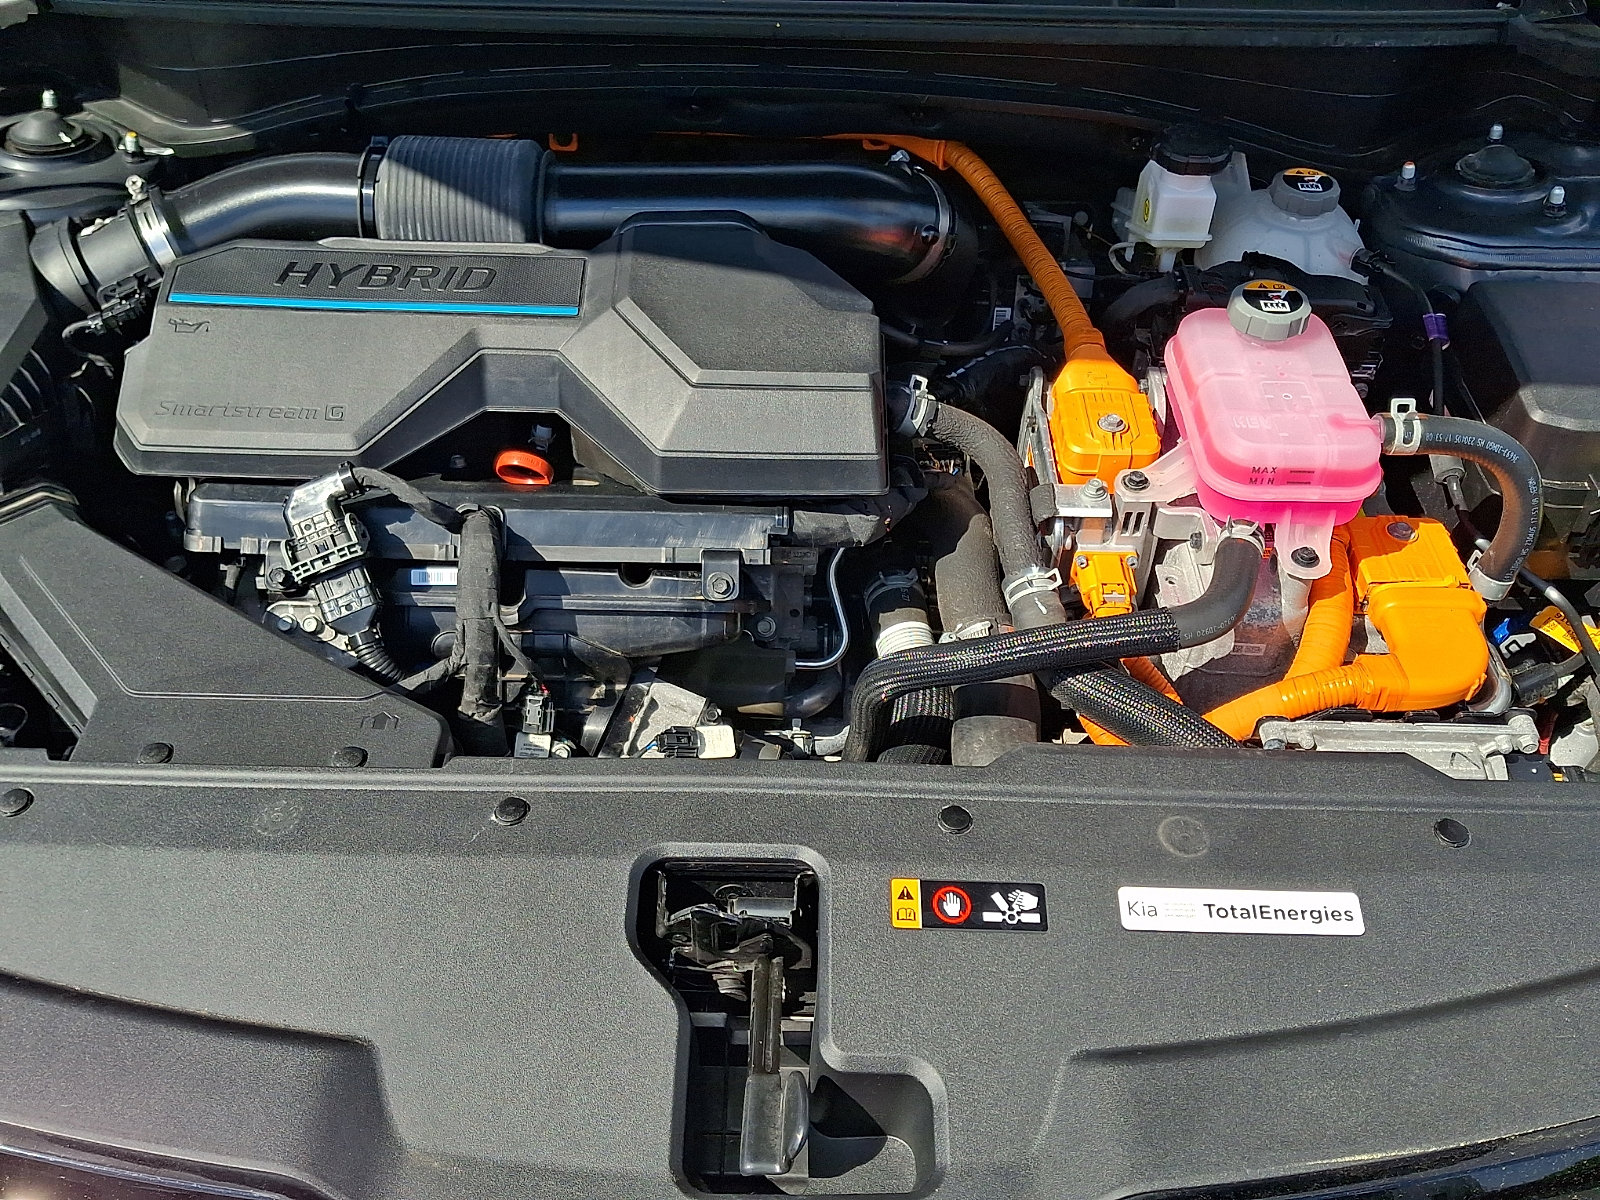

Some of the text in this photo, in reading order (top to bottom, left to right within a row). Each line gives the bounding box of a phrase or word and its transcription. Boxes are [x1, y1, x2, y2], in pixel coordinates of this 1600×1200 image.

[273, 262, 497, 292] HYBRID
[154, 400, 346, 421] Smartstream G
[1252, 466, 1278, 474] MAX
[1248, 477, 1275, 485] MIN
[1127, 900, 1158, 917] Kia
[1203, 903, 1354, 924] TotalEnergies
